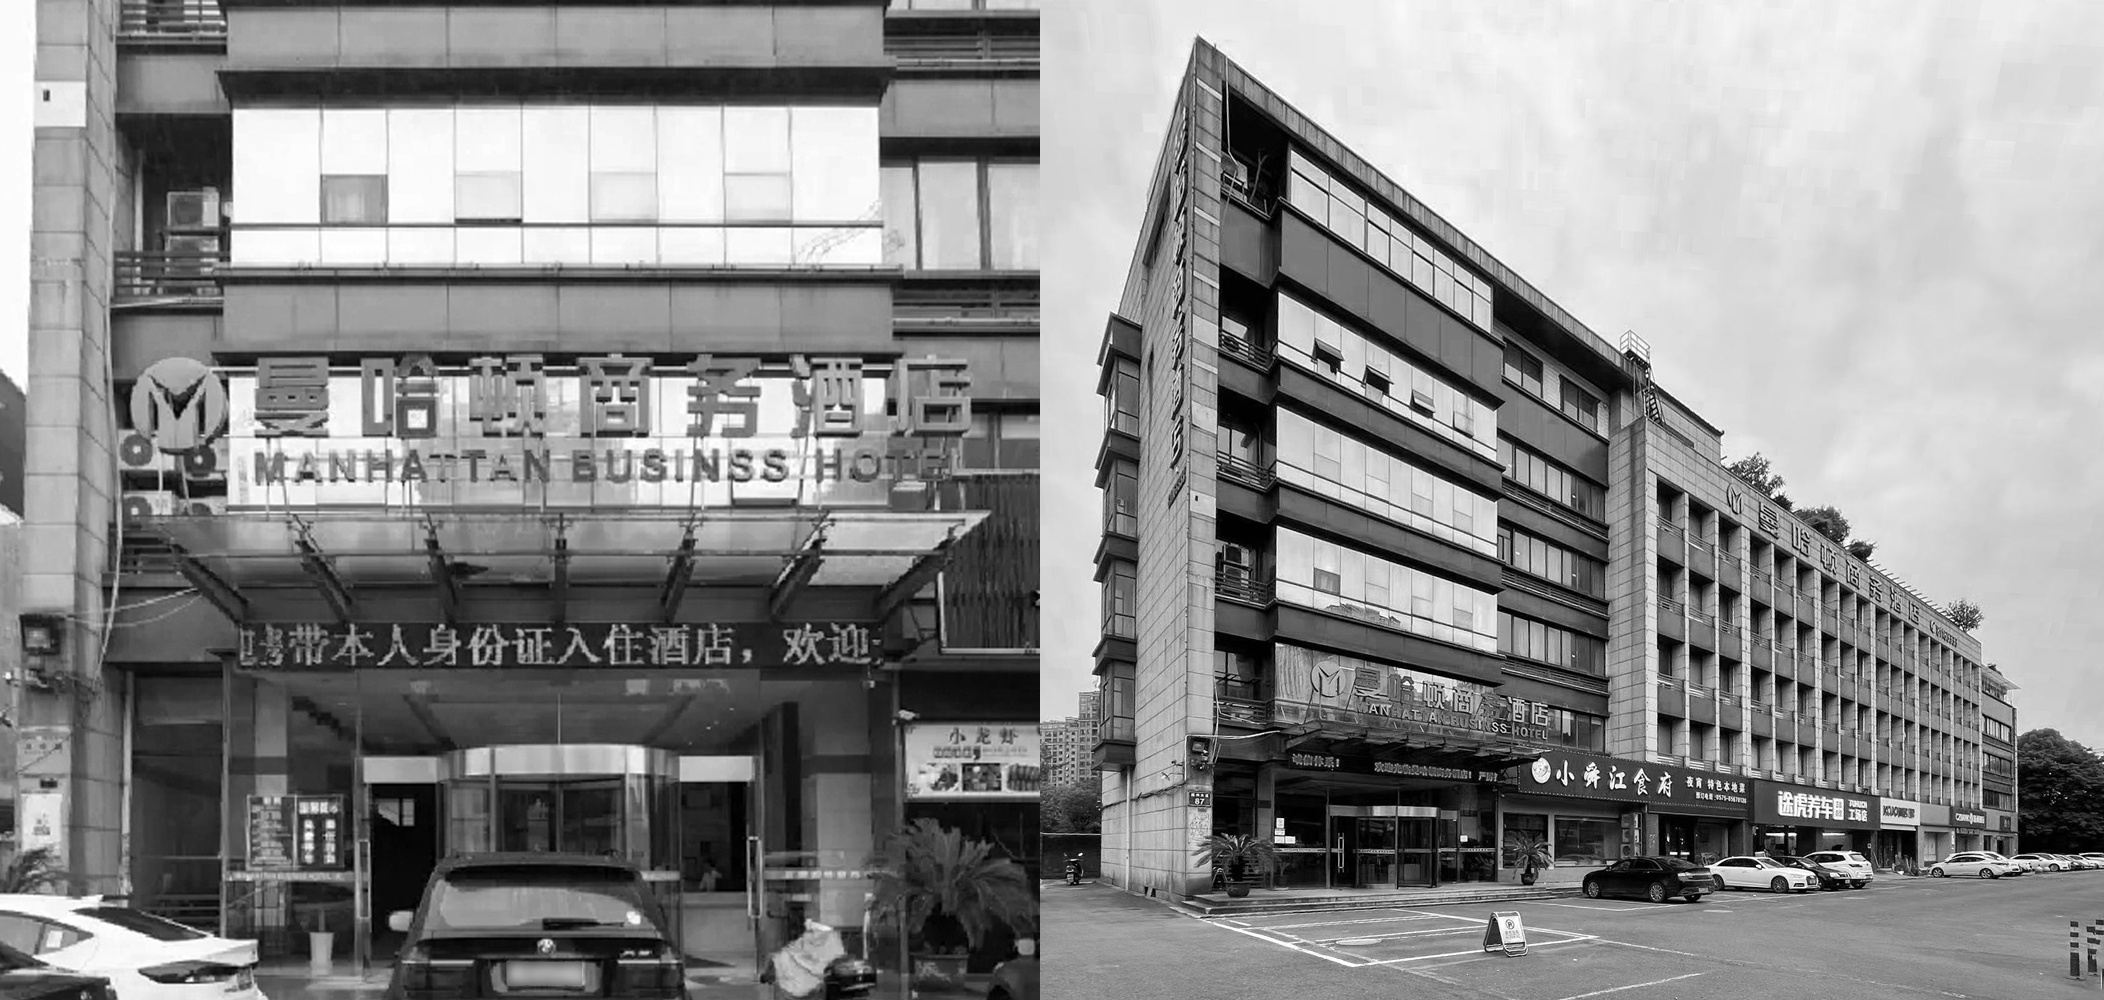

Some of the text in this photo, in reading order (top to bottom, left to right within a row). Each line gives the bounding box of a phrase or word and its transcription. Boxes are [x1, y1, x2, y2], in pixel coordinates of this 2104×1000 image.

[254, 353, 972, 438] 曼哈顿商务酒店
[254, 447, 551, 486] MANHATTAN
[571, 447, 789, 483] BUSINSS
[1759, 501, 1920, 625] 曼哈顿商务酒店
[1354, 666, 1550, 727] 曼哈顿商务酒店
[1356, 701, 1549, 740] MANHATTAN BUSINSS HOTEL
[1555, 759, 1673, 798] 小舜江食府
[1686, 776, 1746, 793] 夜宵 特色本地菜
[1194, 797, 1205, 805] 87
[1777, 790, 1833, 820] 途虎养车
[1848, 808, 1868, 823] 工场店
